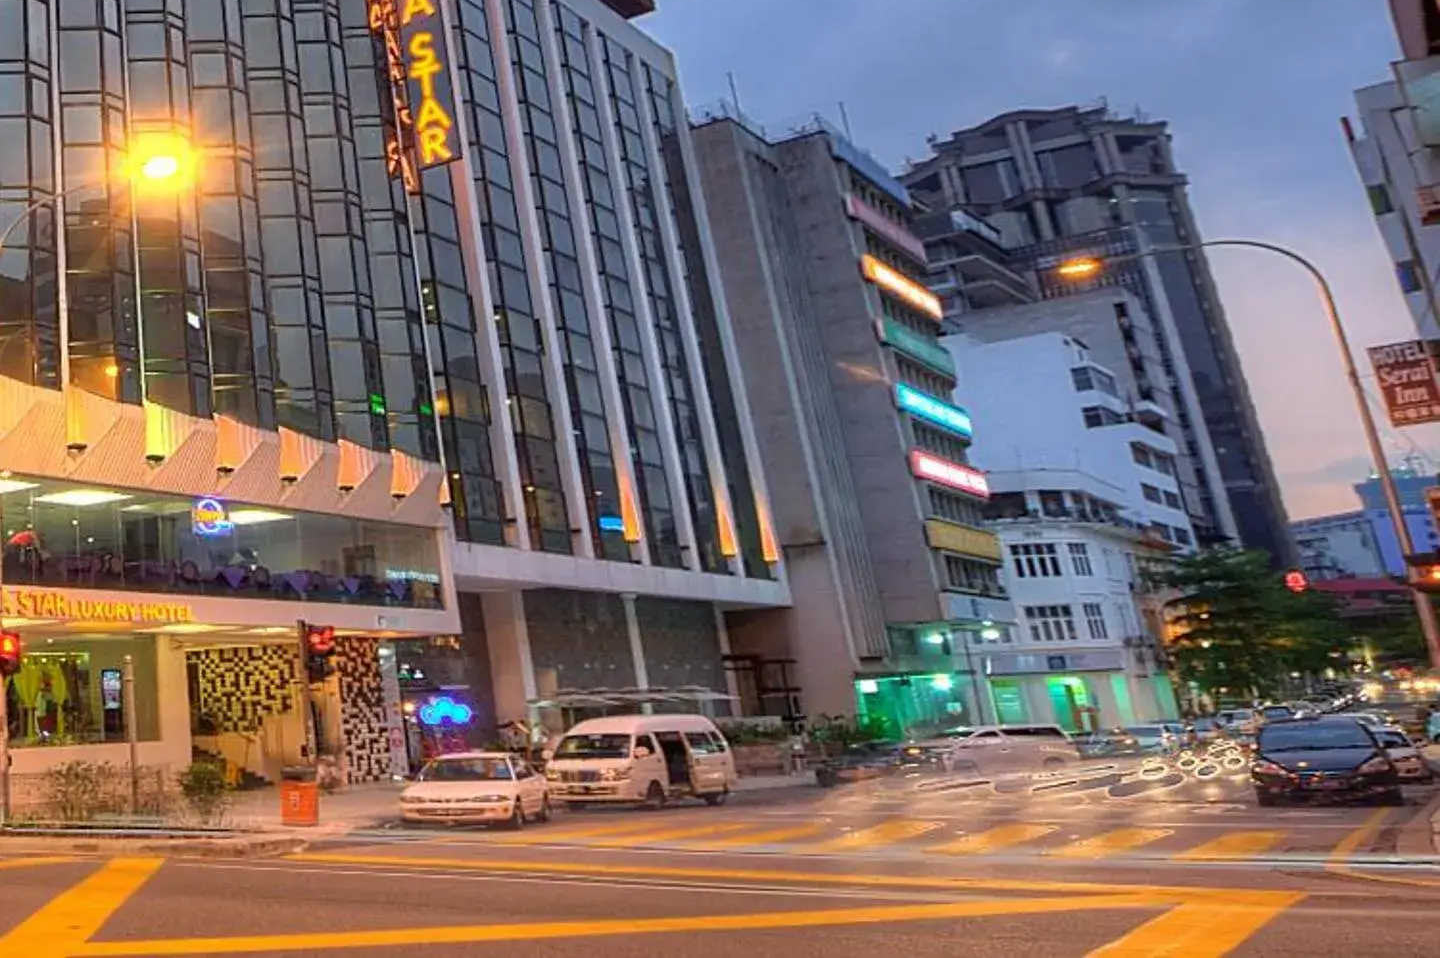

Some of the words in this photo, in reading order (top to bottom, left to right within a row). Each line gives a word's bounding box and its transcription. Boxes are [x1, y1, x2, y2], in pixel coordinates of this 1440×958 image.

[409, 31, 453, 164] STAR
[1372, 343, 1428, 364] HOTEL
[1394, 386, 1430, 404] Inn
[16, 590, 69, 617] STAR
[71, 599, 136, 623] LUXURY
[140, 601, 198, 624] HOTEL
